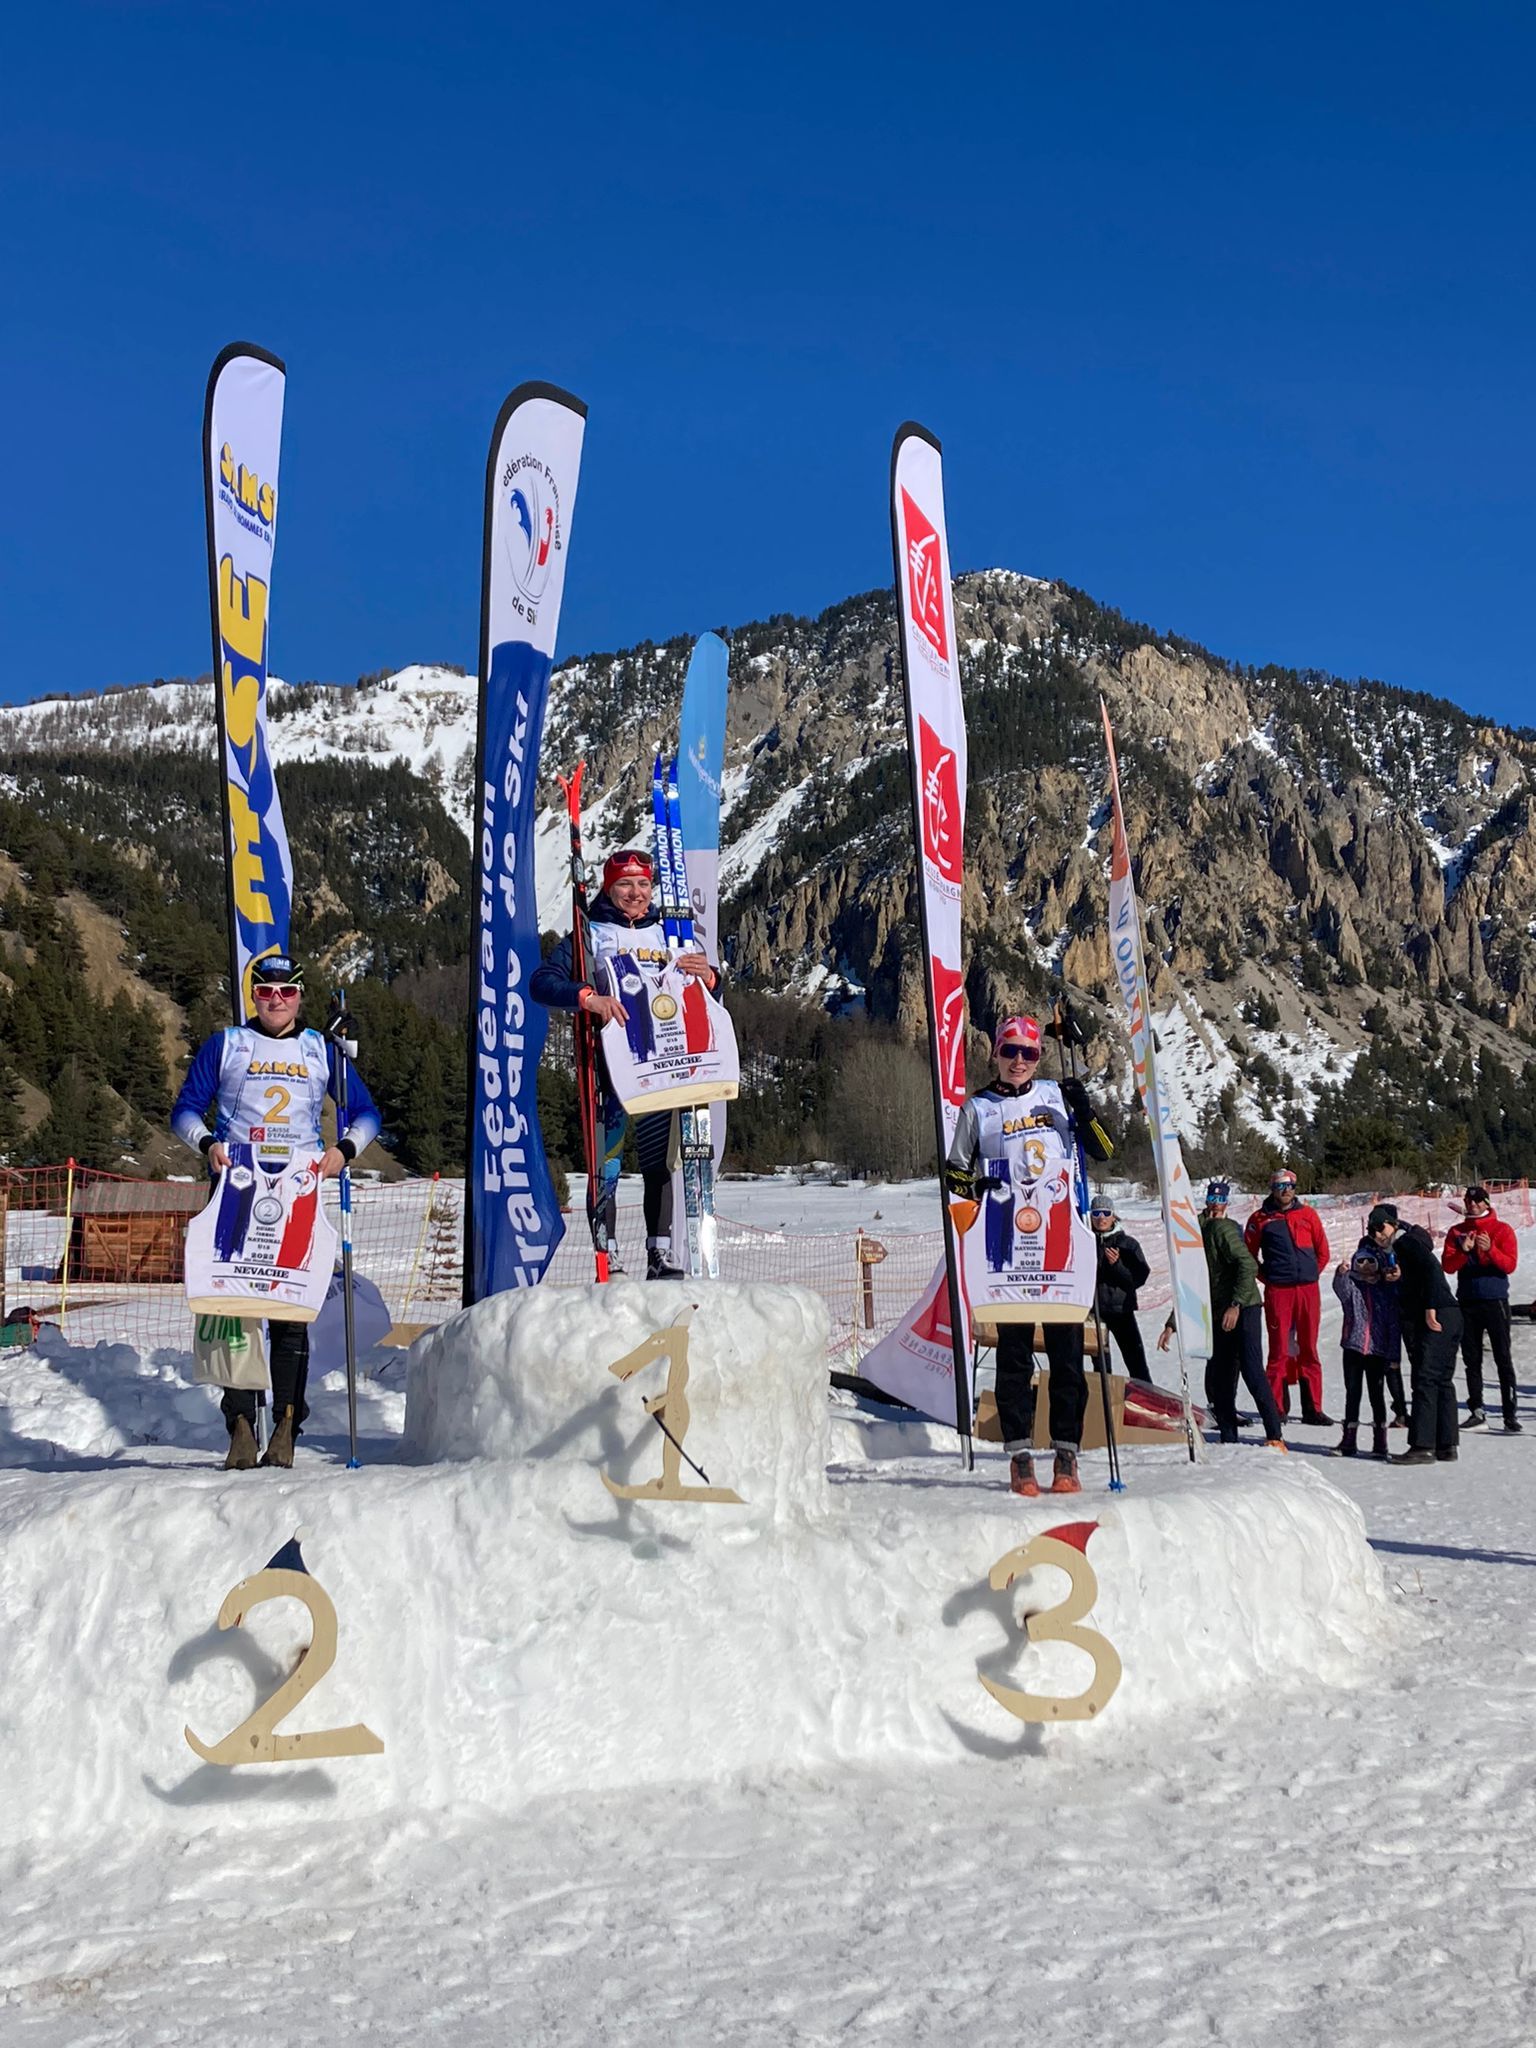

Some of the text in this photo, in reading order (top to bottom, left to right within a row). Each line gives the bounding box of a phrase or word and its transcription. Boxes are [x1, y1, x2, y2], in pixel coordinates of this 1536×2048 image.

[511, 596, 525, 616] de
[504, 689, 529, 809] Ski
[657, 823, 673, 896] SALOMON
[671, 827, 688, 897] SALOMON
[478, 780, 504, 1193] Fédération
[247, 1061, 310, 1078] SAMSE
[653, 1056, 702, 1070] NEVACHE
[263, 1085, 291, 1124] 2
[267, 1126, 290, 1134] CAISSE
[1002, 1113, 1054, 1136] SAMSE
[1023, 1138, 1046, 1175] 3
[247, 1236, 282, 1244] NATIONAL
[251, 1252, 275, 1260] 2023
[233, 1265, 290, 1279] NEVACHE
[1006, 1273, 1057, 1283] NEVACHE
[975, 1512, 1122, 1723] 3
[184, 1535, 384, 1766] 2
